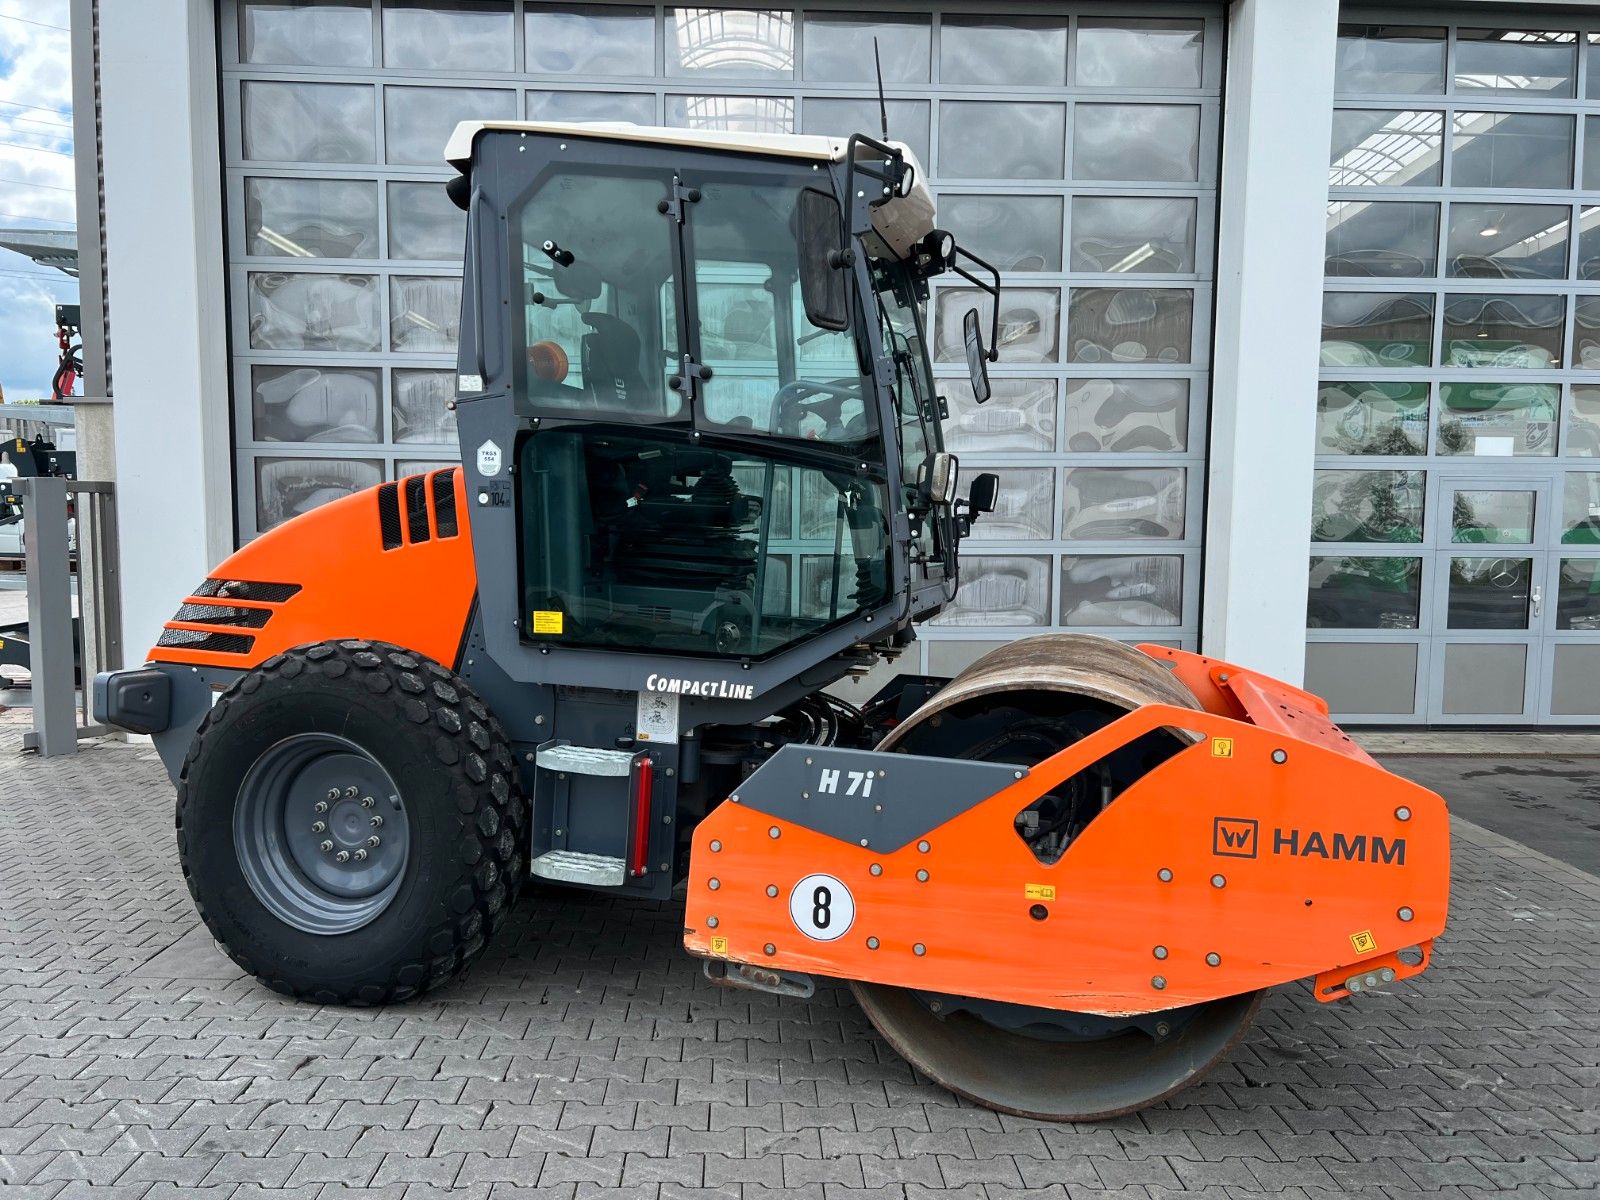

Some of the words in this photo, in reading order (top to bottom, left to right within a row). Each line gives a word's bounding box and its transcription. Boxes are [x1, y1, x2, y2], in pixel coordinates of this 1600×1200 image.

[491, 492, 505, 506] 104
[817, 768, 840, 794] H
[845, 770, 875, 798] 7i
[1273, 828, 1406, 866] HAMM
[812, 885, 832, 929] 8
